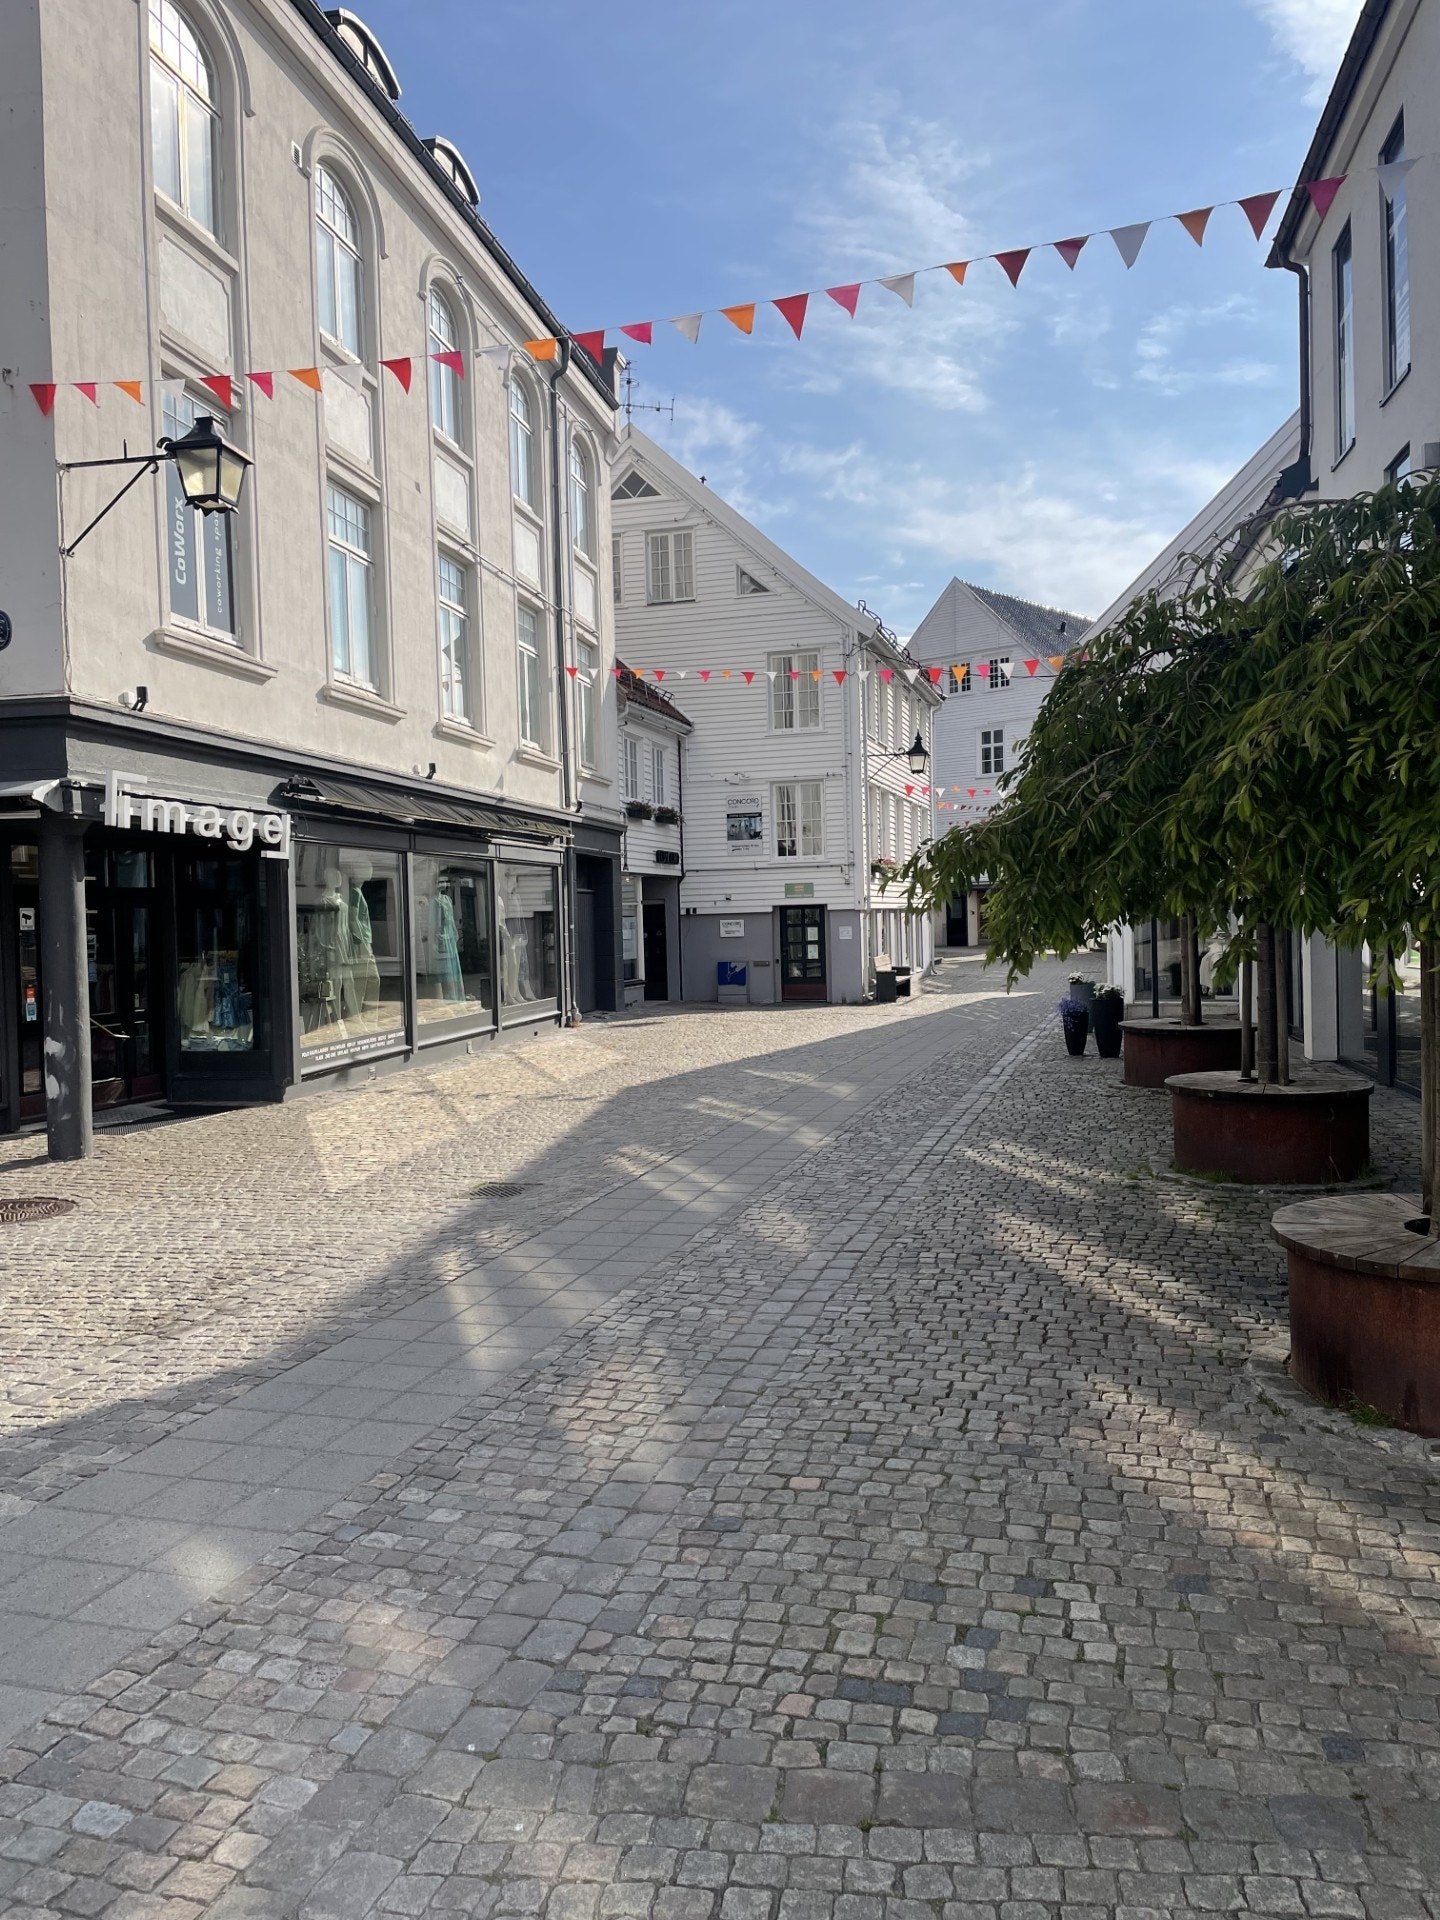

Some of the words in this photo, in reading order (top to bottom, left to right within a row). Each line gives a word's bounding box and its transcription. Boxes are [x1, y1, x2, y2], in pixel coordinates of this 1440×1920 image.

[174, 496, 187, 585] CoWorx
[213, 510, 221, 540] spac
[214, 548, 222, 613] coworking
